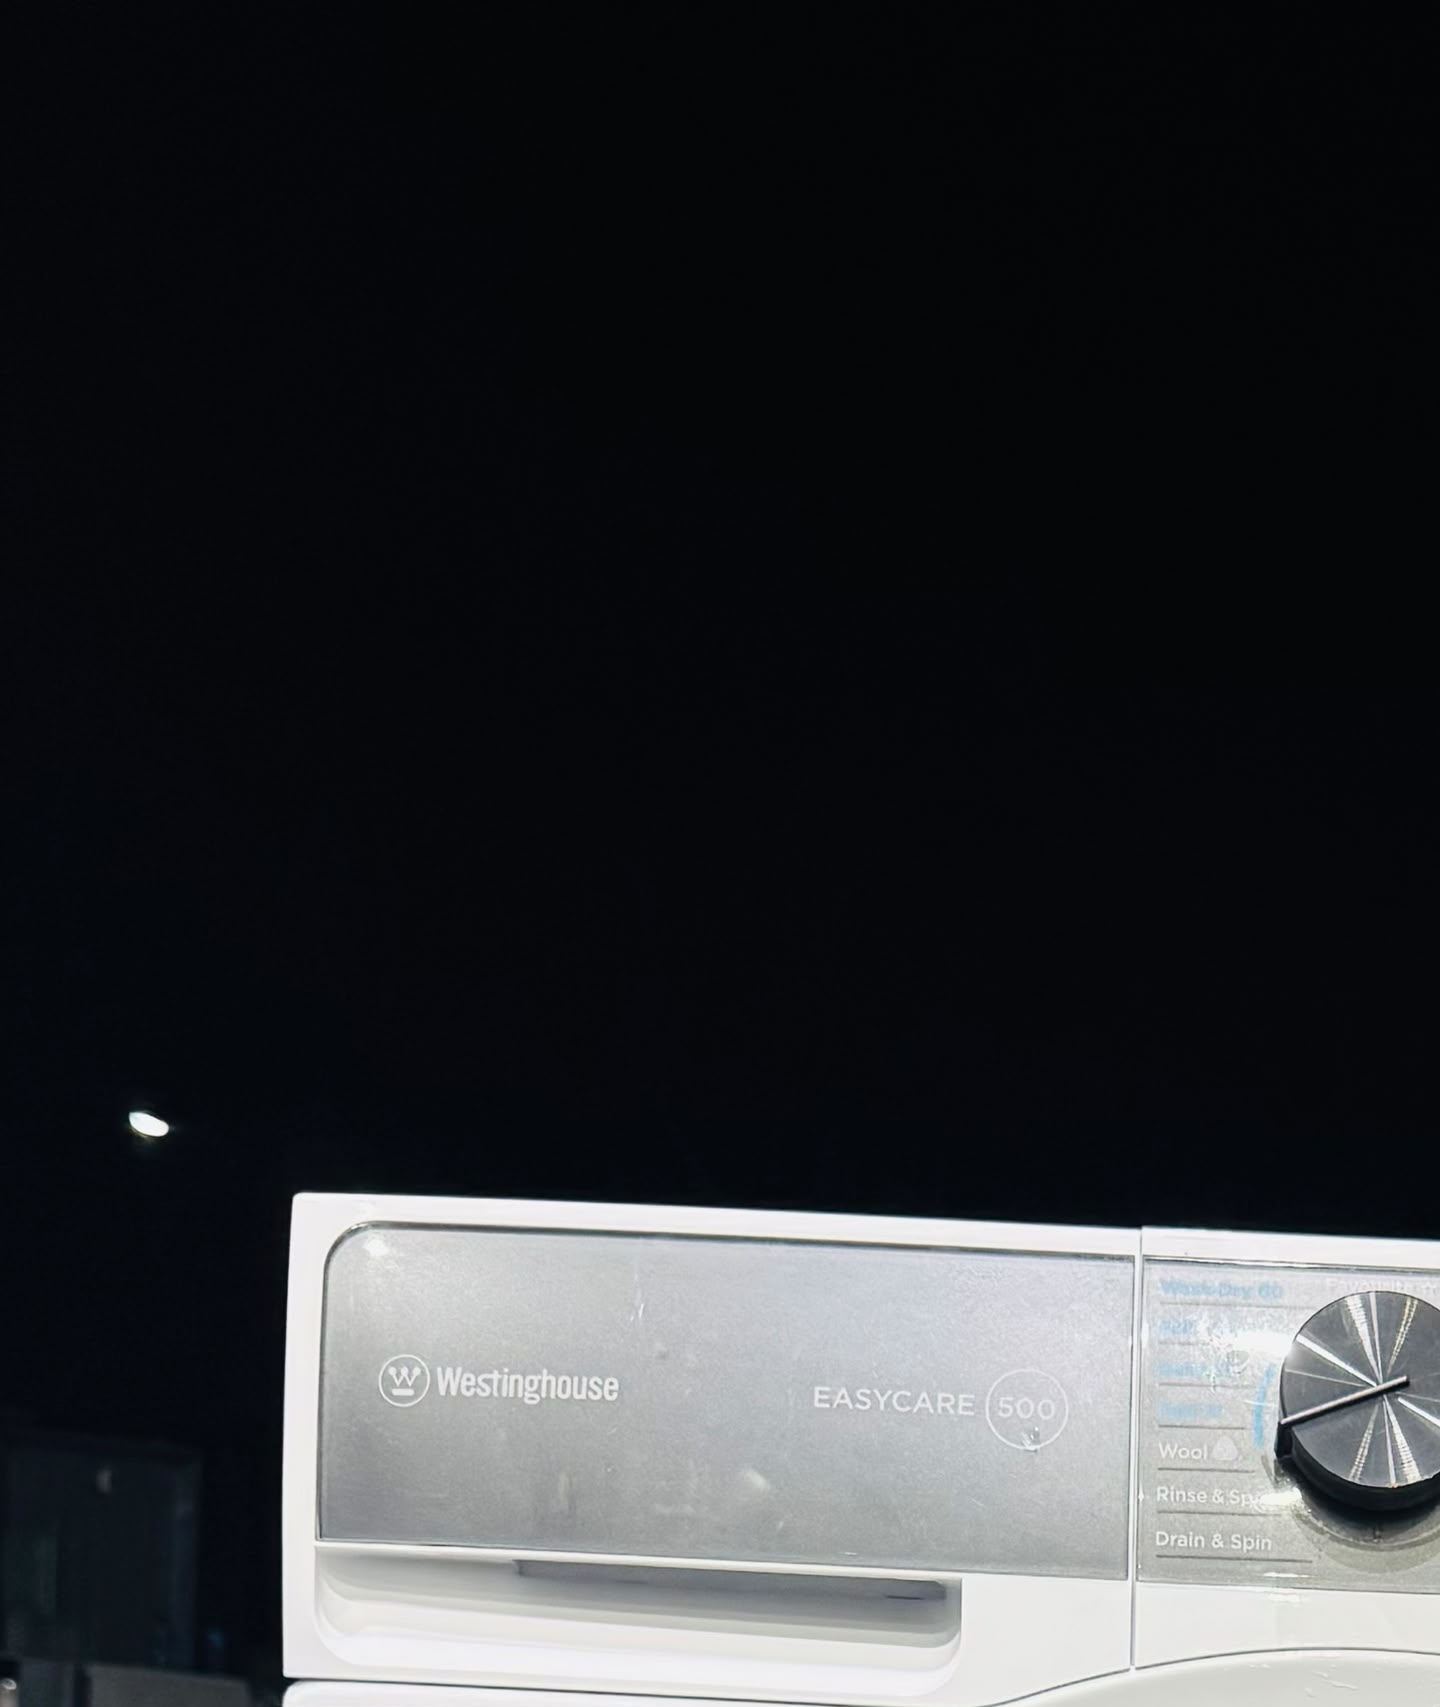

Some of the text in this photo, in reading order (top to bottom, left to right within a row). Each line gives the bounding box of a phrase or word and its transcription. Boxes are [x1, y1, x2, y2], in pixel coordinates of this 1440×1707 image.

[436, 1366, 619, 1405] Westinghouse
[813, 1386, 1056, 1421] EASYCARE 500
[1158, 1440, 1208, 1460] Wool
[1156, 1485, 1208, 1502] Rinse
[1212, 1488, 1225, 1504] &
[1155, 1530, 1273, 1552] Drain & Spin
